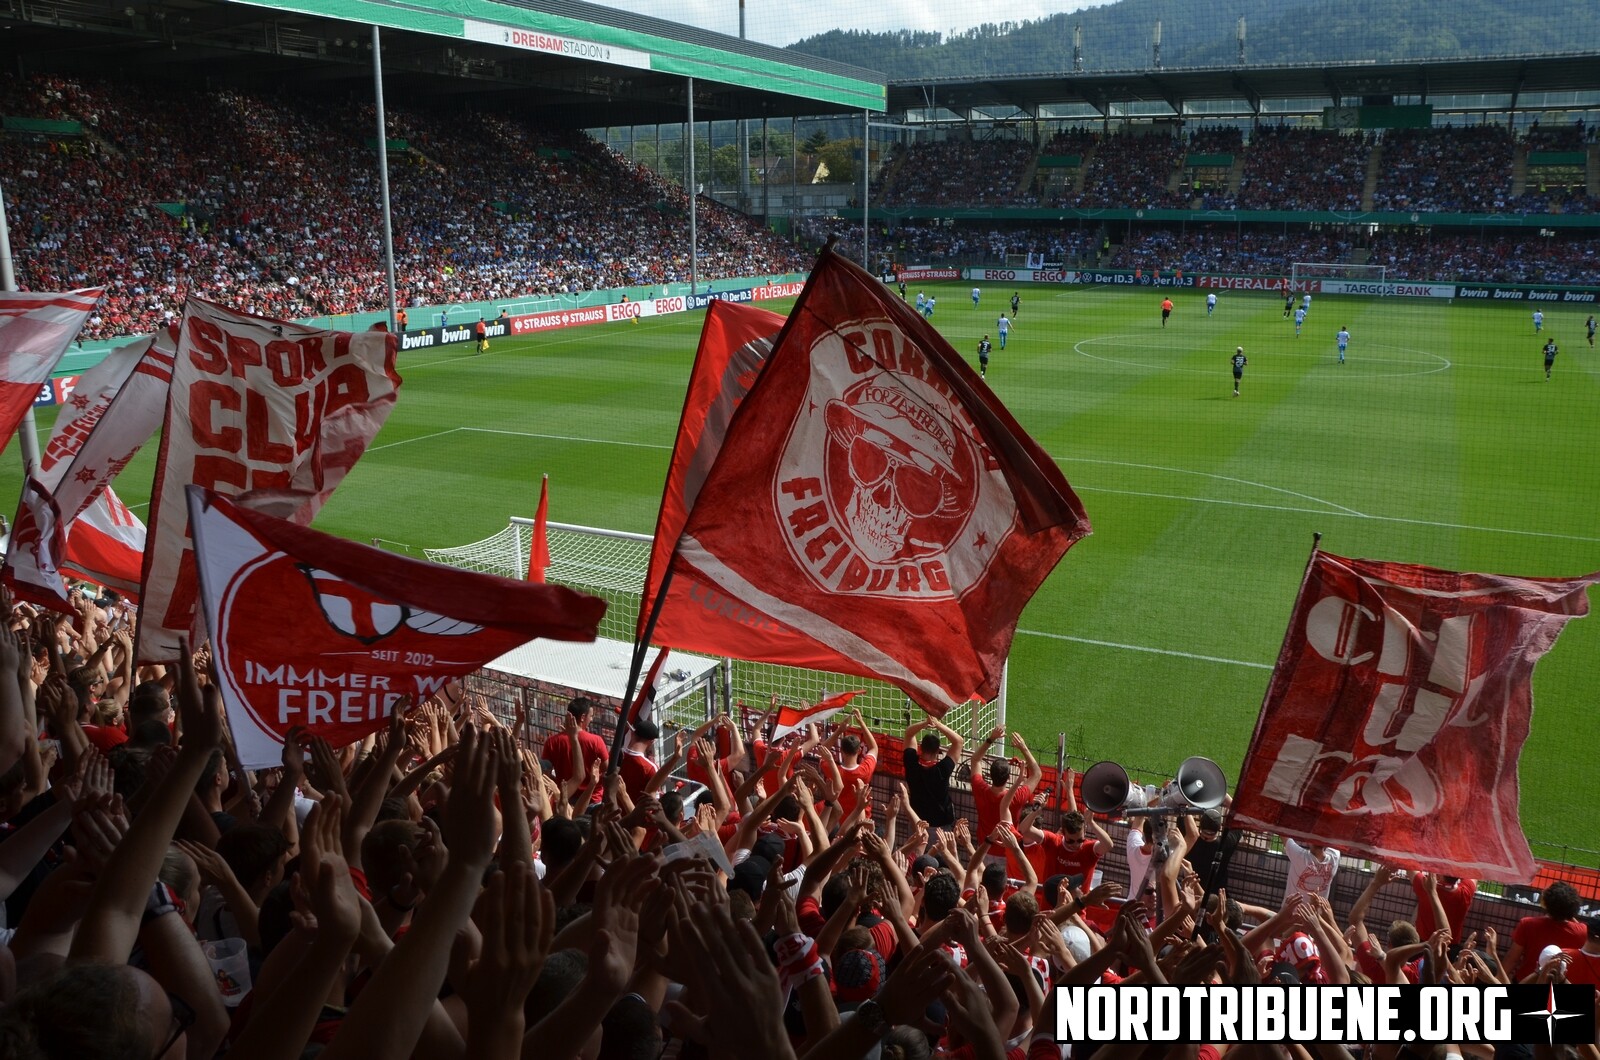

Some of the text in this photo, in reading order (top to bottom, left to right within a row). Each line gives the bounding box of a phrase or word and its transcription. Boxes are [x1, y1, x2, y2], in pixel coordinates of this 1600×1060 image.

[512, 31, 603, 59] DREISAMSTADION
[927, 270, 957, 278] STRAUSS
[985, 269, 1016, 280] ERGO
[1033, 271, 1063, 282] ERGO
[1095, 274, 1134, 284] Der ID.3
[730, 292, 740, 302] Der
[1460, 287, 1488, 298] bwin
[1494, 288, 1523, 299] bwin
[1528, 290, 1558, 300] bwin
[1564, 291, 1595, 302] bwin
[656, 296, 683, 313] ERGO
[695, 296, 706, 307] Der
[570, 310, 604, 324] STRAUSS
[611, 302, 641, 320] ERGO
[485, 320, 505, 337] win
[524, 316, 561, 330] STRAUSS
[402, 330, 434, 350] bwin
[441, 325, 471, 344] bwin
[865, 388, 955, 456] FORZA FREIBRG
[781, 476, 950, 592] FREIBURG
[371, 650, 434, 667] SEIT 2012
[278, 688, 427, 724] FREIB
